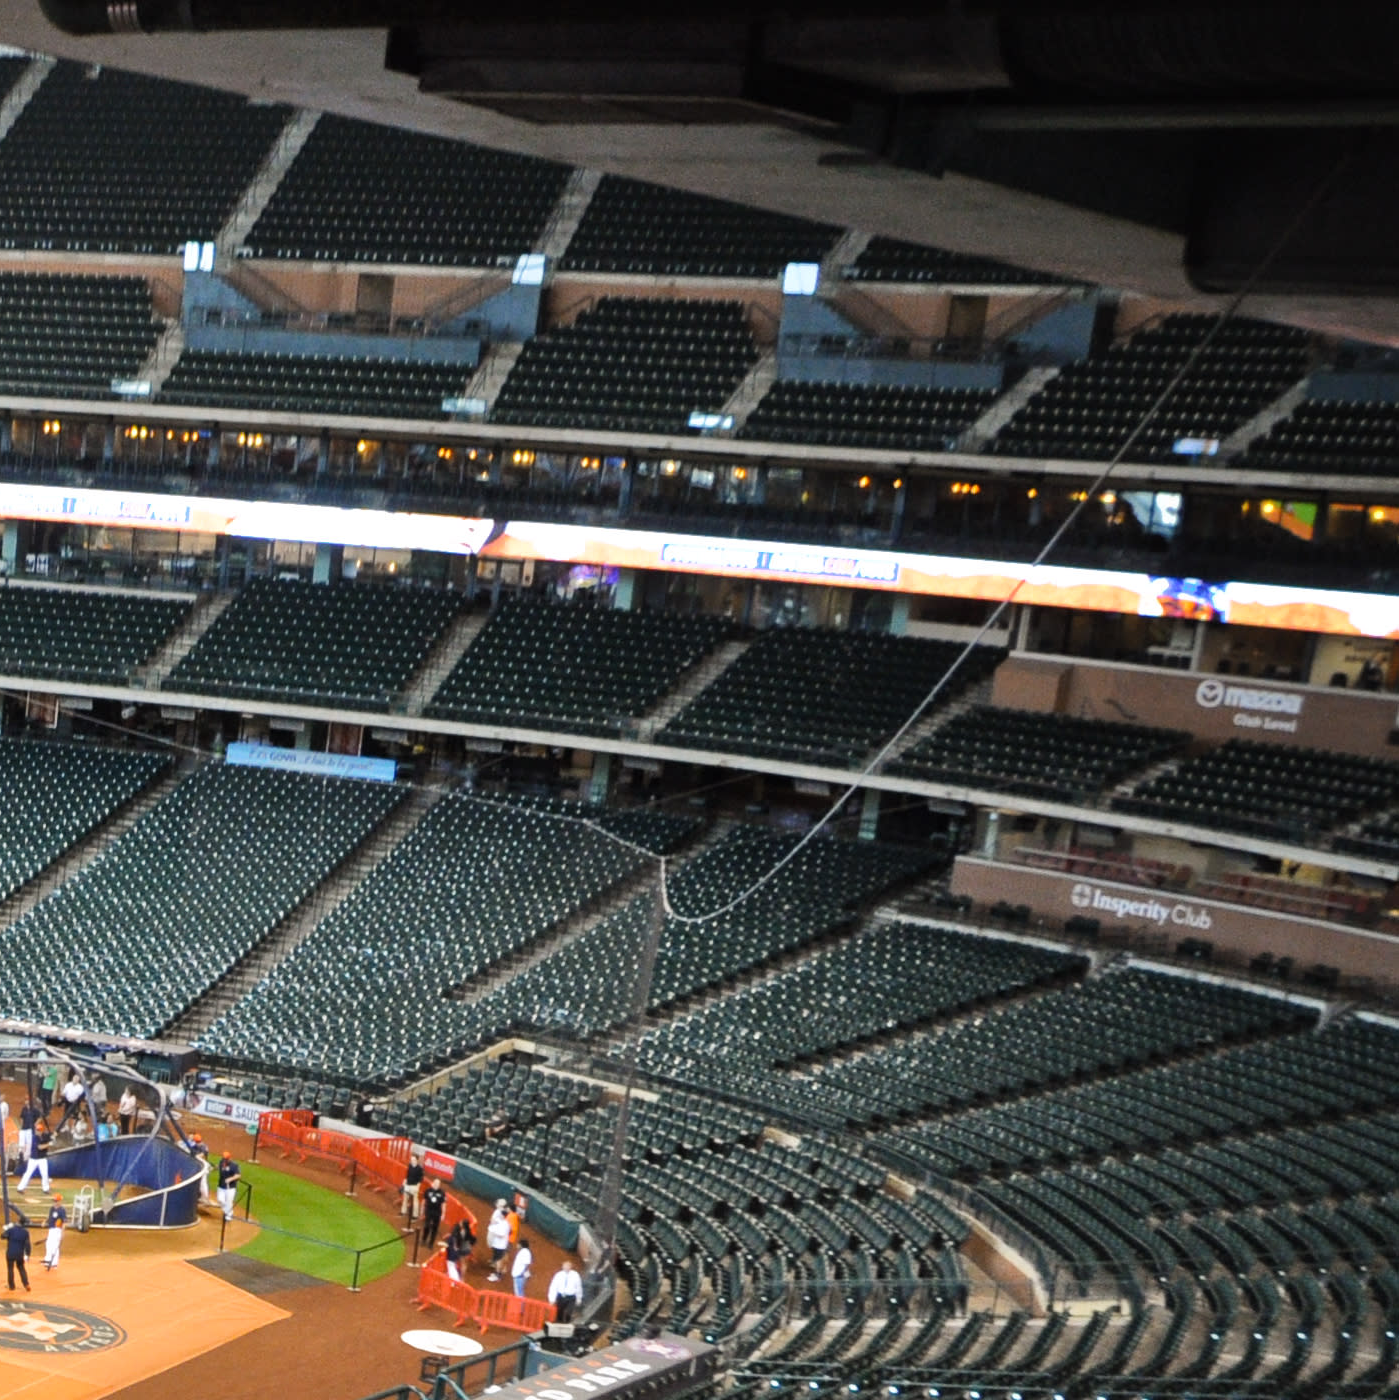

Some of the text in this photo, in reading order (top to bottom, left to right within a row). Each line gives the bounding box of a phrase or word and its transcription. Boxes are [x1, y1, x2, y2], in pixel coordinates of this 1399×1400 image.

[1224, 687, 1304, 714] mazda
[1093, 889, 1212, 930] Insperity Club
[235, 1105, 259, 1121] SAUC
[44, 1324, 116, 1353] ASTROS
[564, 1358, 651, 1393] PARK
